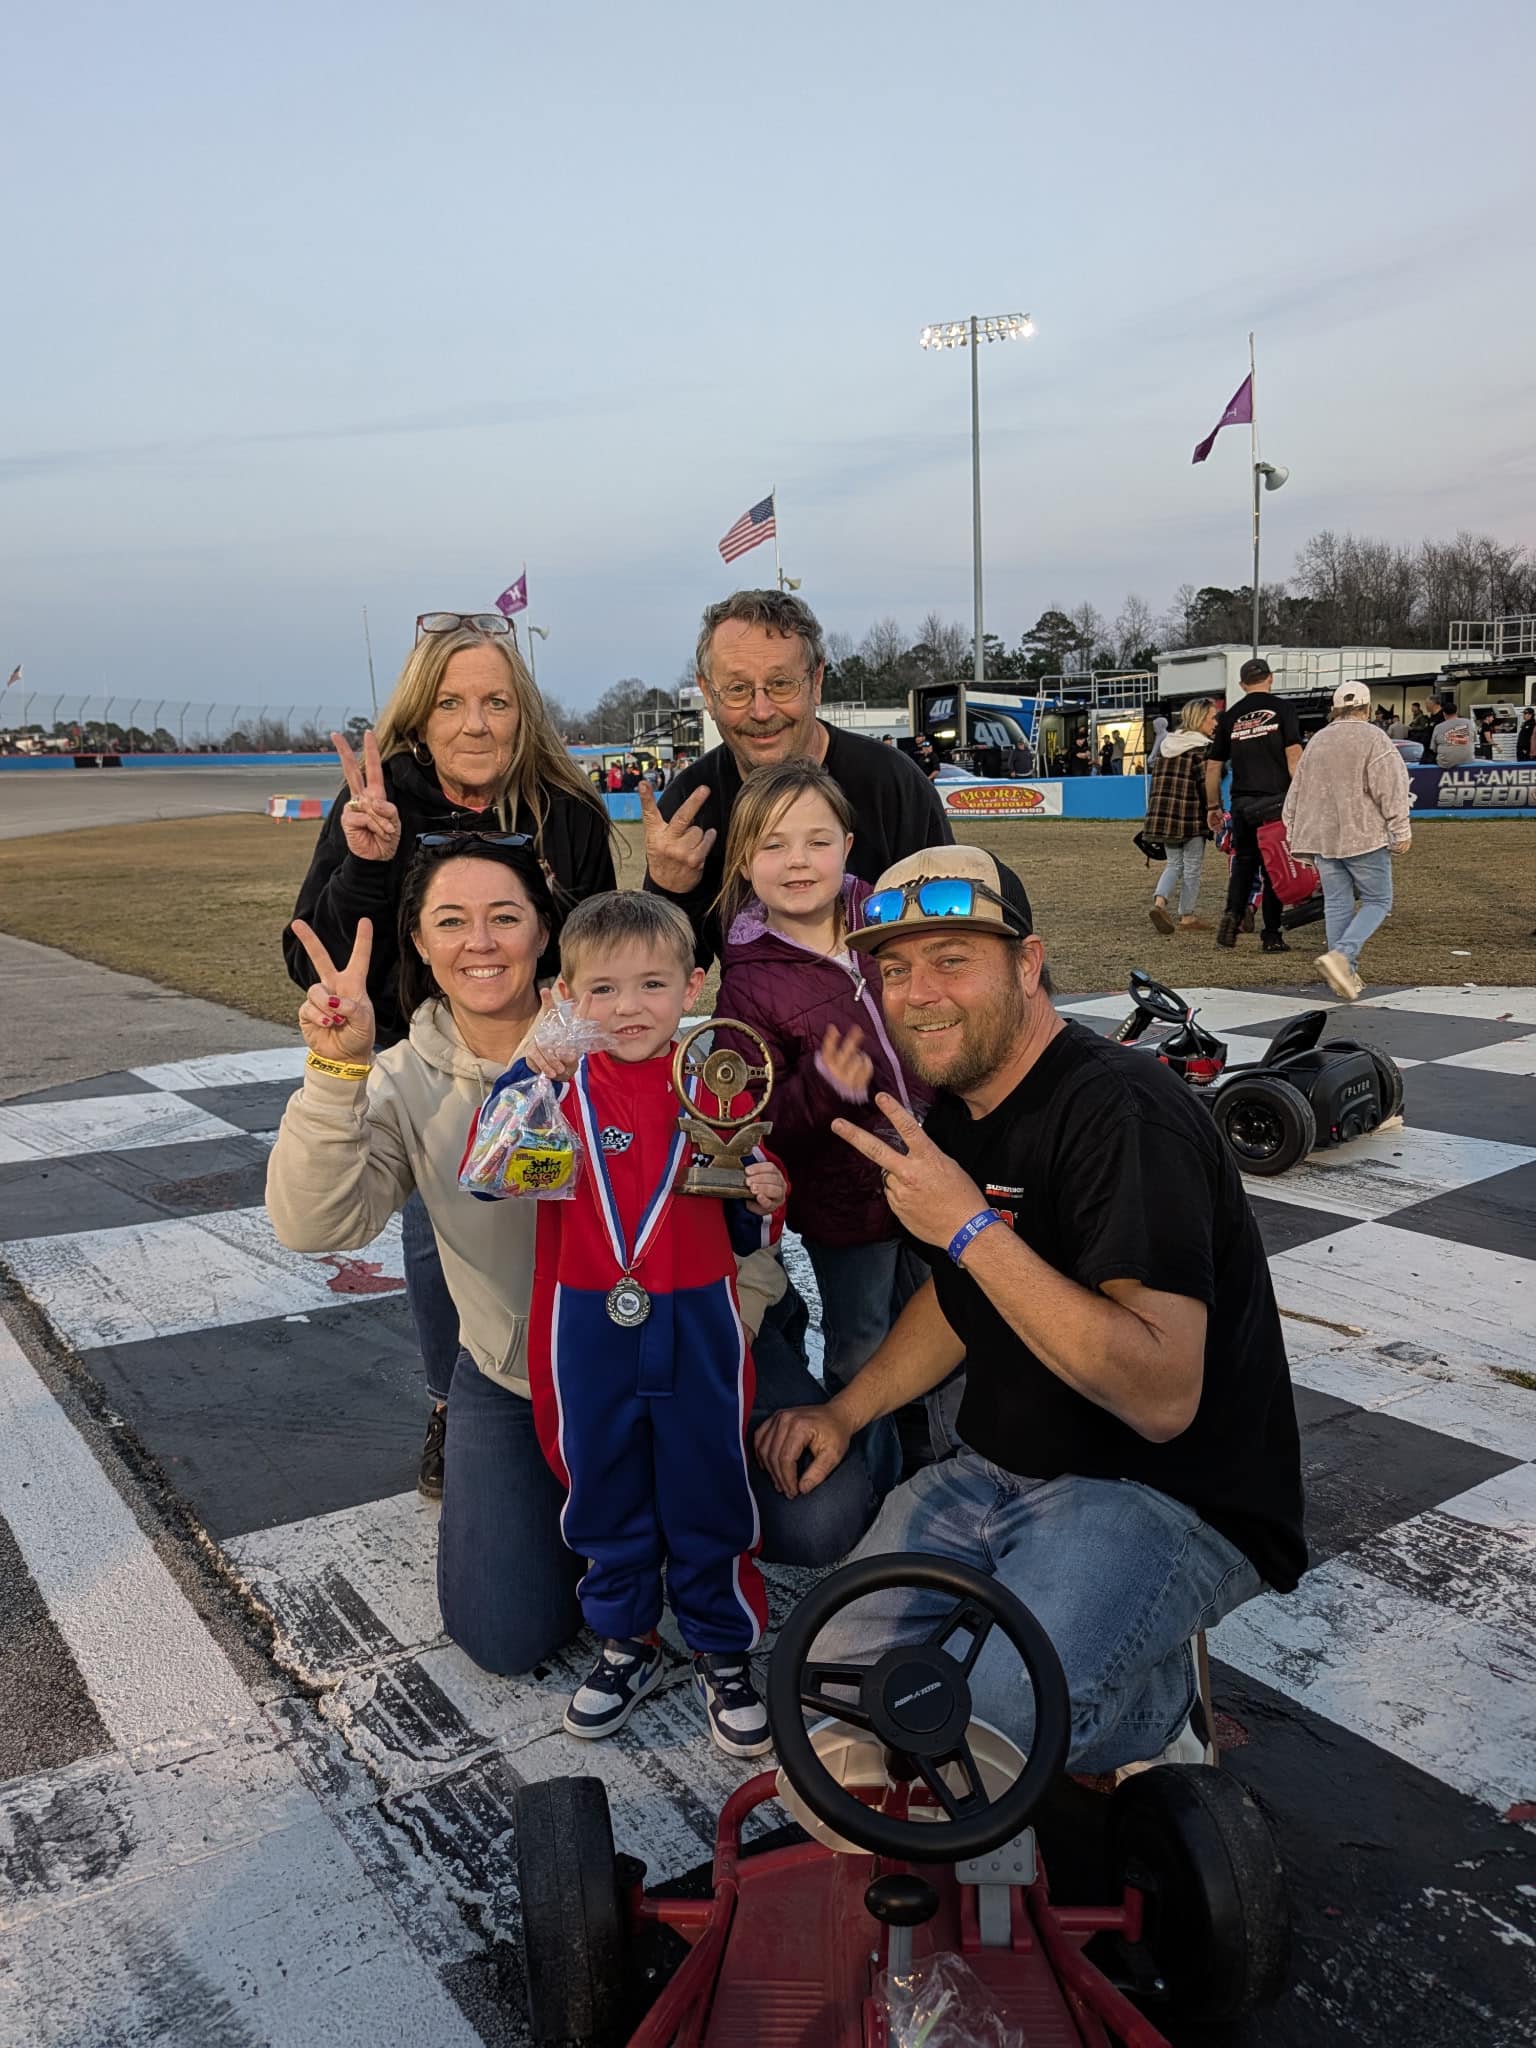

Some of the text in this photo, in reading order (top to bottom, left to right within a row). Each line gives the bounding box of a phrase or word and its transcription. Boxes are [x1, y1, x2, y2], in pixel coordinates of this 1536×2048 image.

[929, 699, 954, 717] 40
[973, 721, 1012, 748] 40
[1438, 771, 1475, 787] ALL
[1347, 1079, 1370, 1097] FLYER
[523, 1171, 561, 1182] PATCH
[526, 1164, 561, 1174] SOUR
